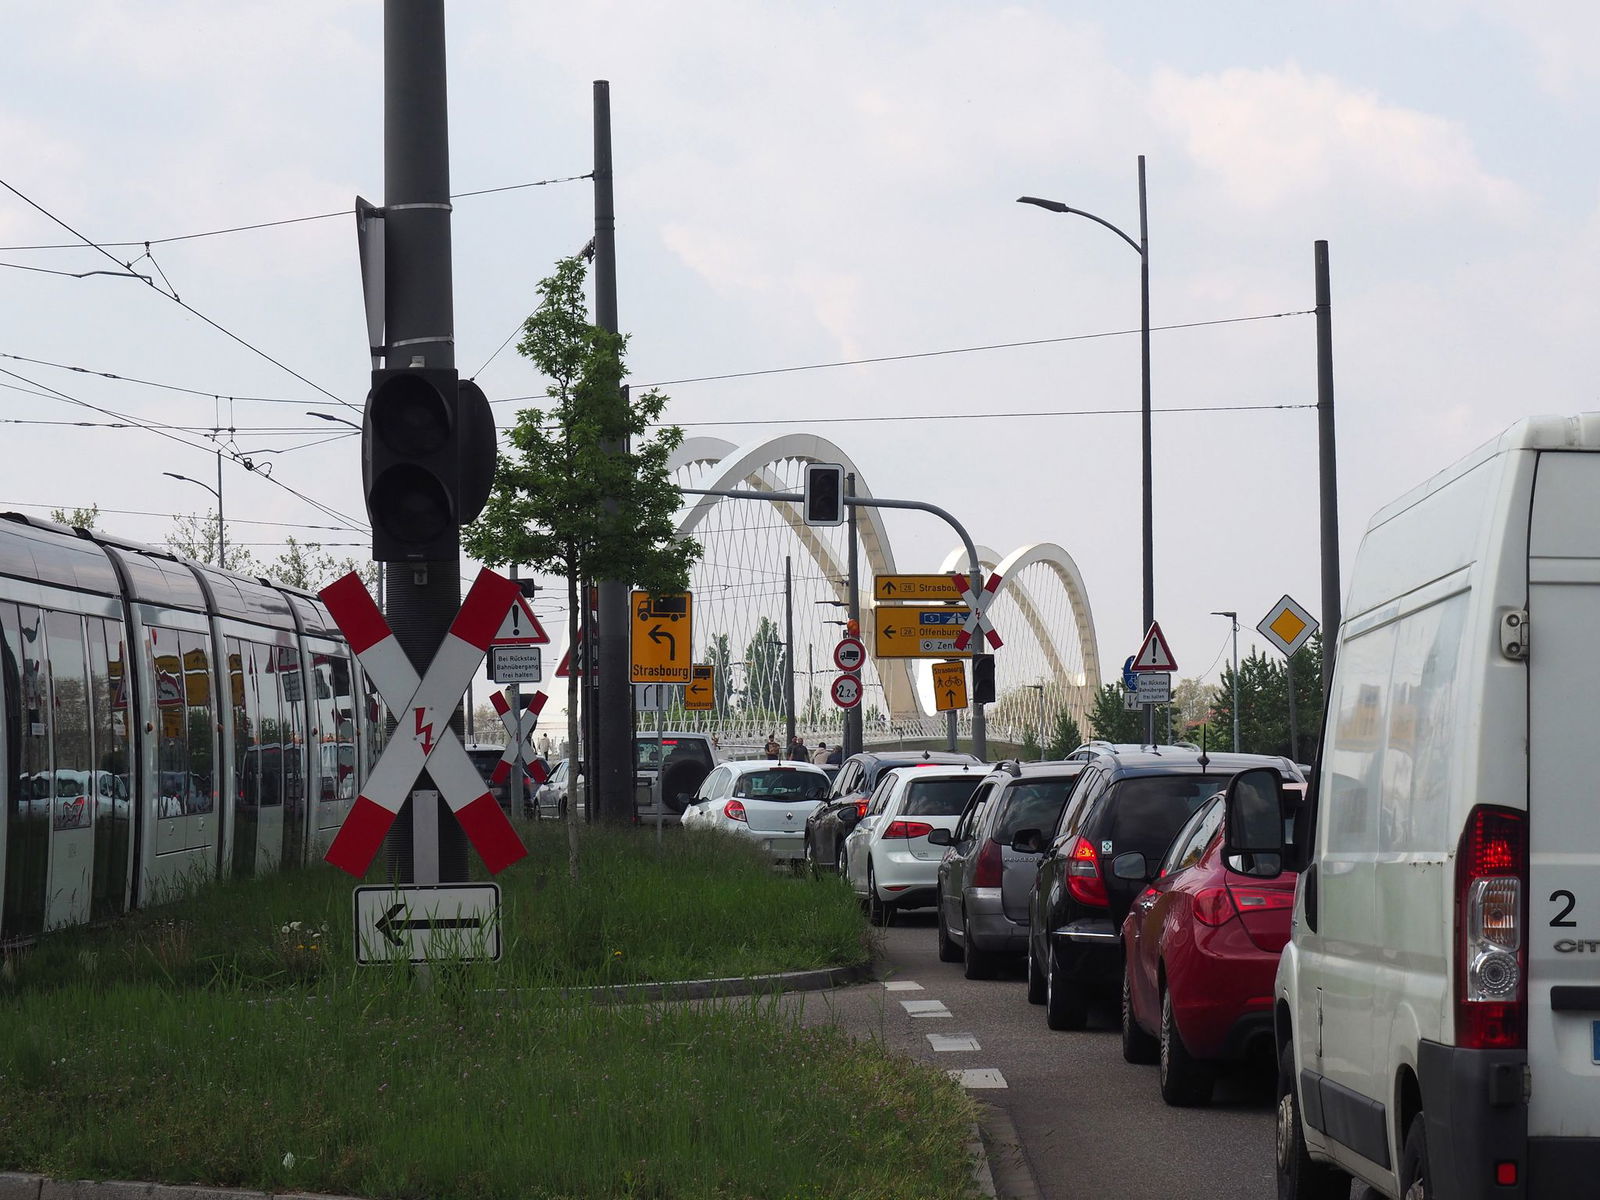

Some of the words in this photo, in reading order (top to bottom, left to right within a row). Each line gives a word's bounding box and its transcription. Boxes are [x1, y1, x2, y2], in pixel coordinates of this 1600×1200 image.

[919, 583, 958, 592] Strasbou
[633, 664, 689, 680] Strasbourg
[1549, 889, 1577, 928] 2
